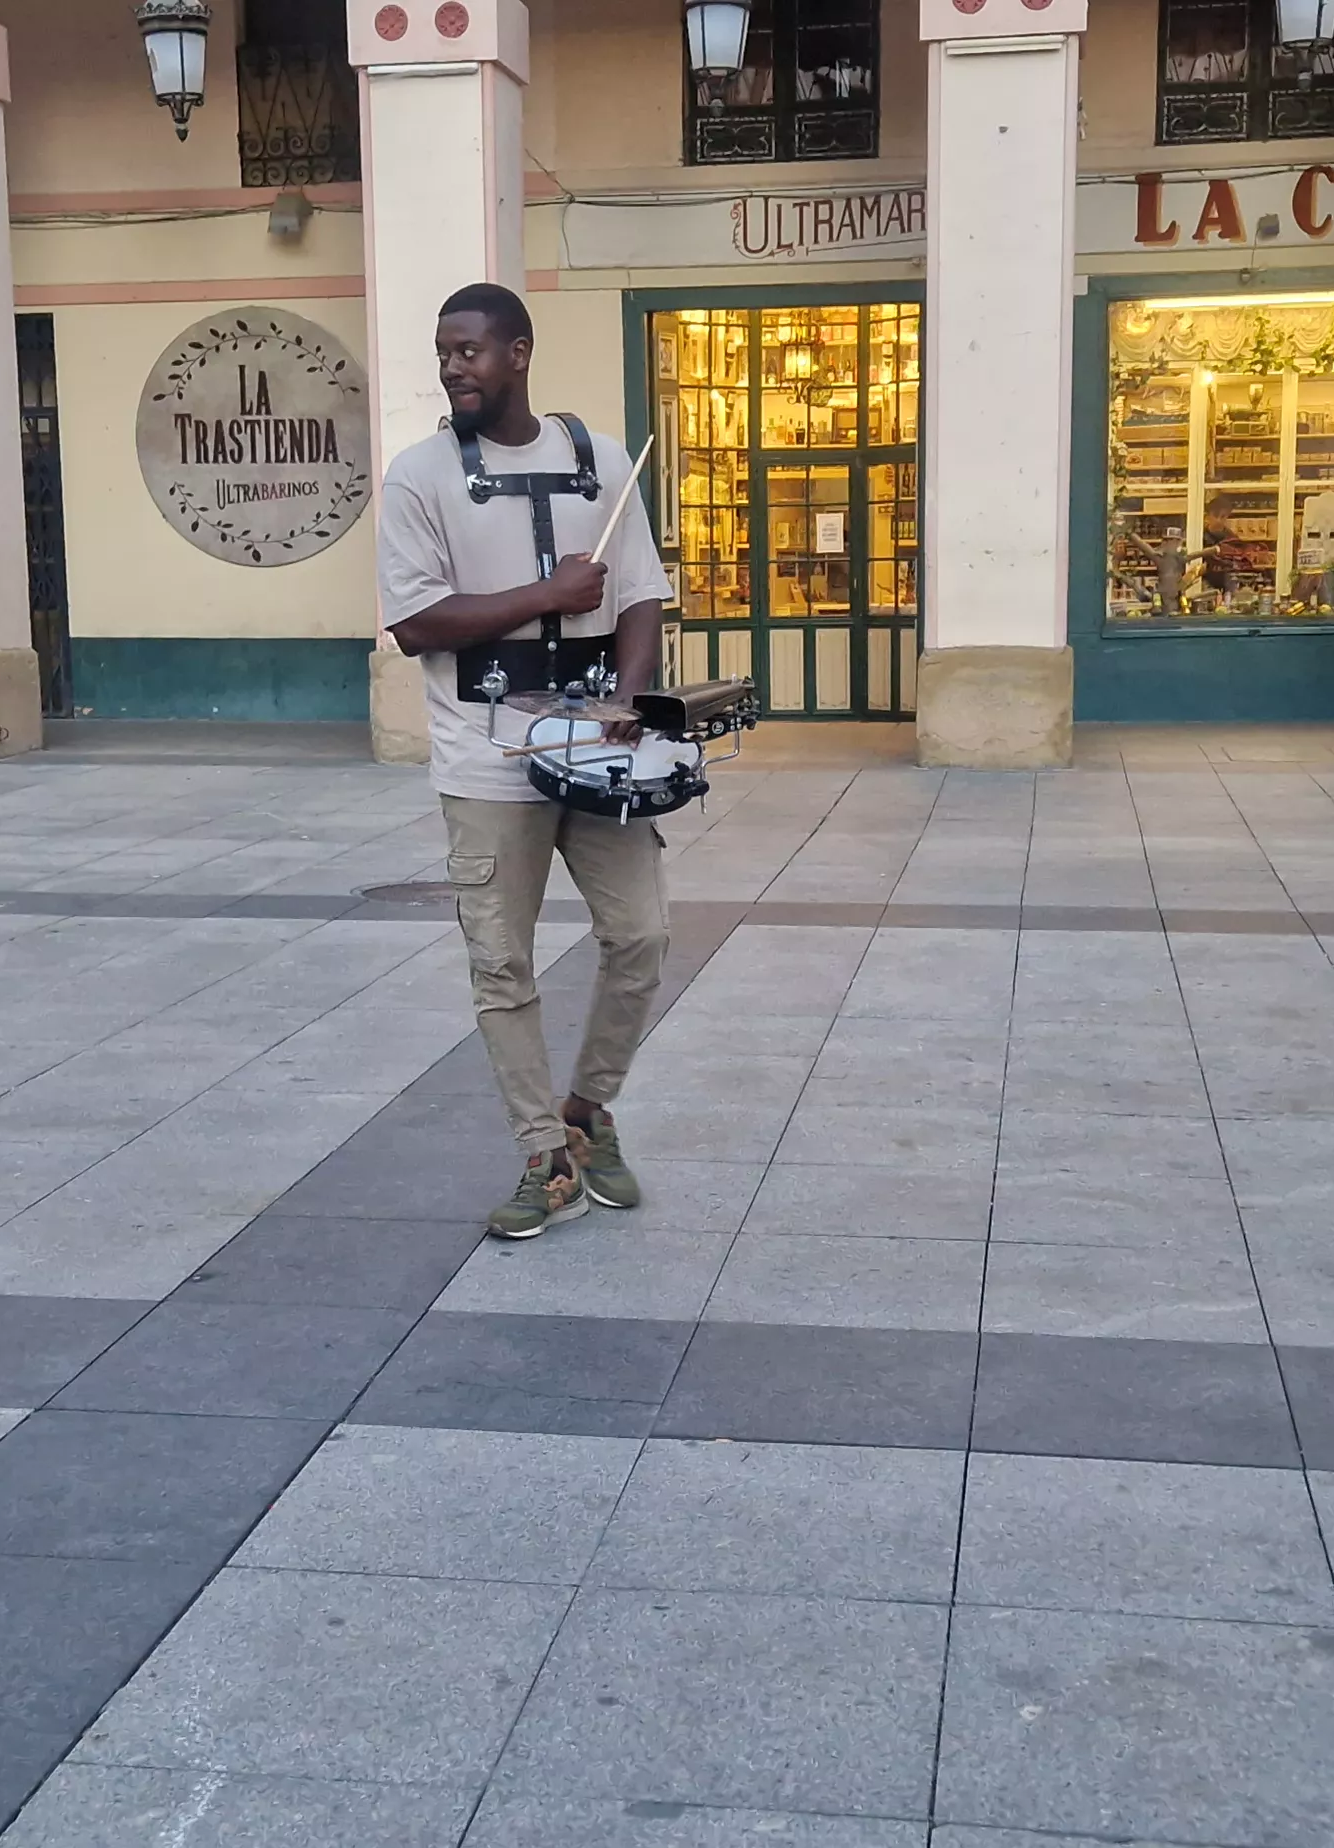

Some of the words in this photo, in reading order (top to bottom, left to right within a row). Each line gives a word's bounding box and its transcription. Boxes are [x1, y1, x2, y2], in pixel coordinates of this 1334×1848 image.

[1135, 172, 1248, 247] LA
[238, 364, 272, 416] LA
[174, 413, 340, 464] TRASTIENDA
[216, 478, 320, 510] ULTRABARINOS
